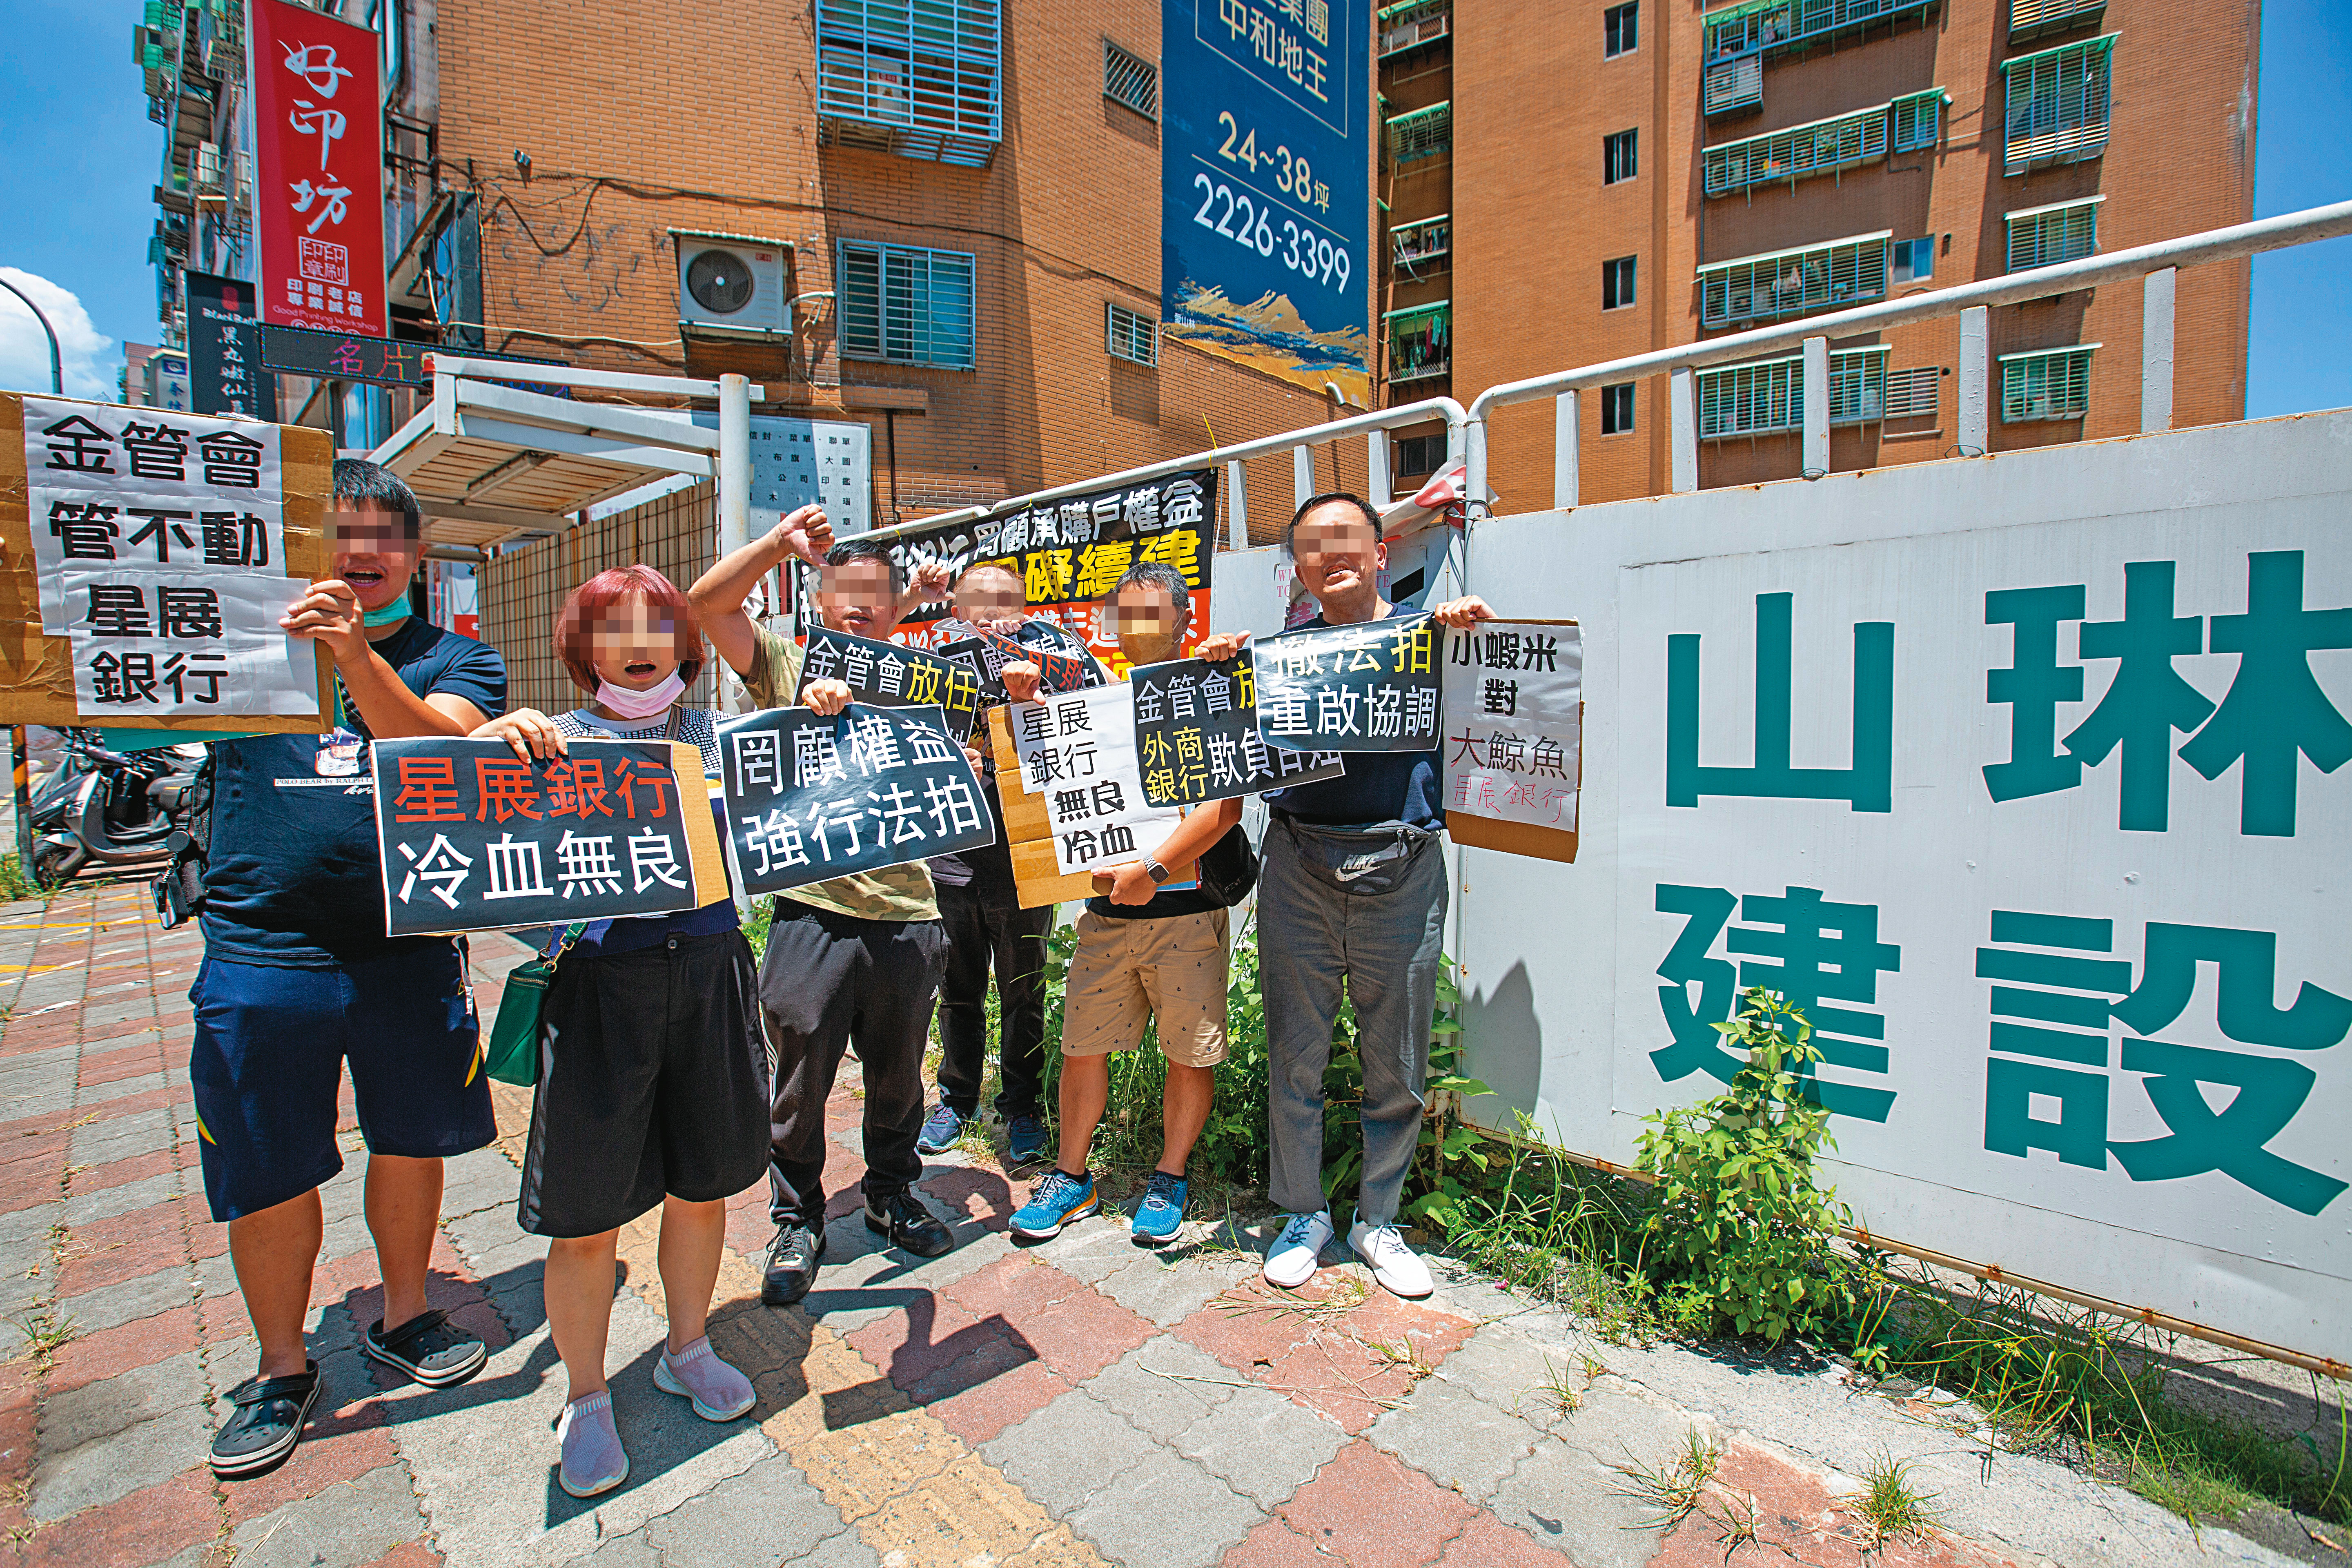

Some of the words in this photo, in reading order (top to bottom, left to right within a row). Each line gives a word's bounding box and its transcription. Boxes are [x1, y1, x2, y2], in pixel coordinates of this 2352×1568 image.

[1220, 0, 1328, 103] 中和地王
[277, 40, 353, 234] 好印坊
[1193, 173, 1350, 294] 2226-3399
[287, 278, 363, 305] 印刷老店
[287, 291, 363, 318] 專業誠信
[273, 305, 298, 316] Good
[299, 309, 334, 324] Printing
[334, 316, 378, 332] Workshop
[1174, 312, 1196, 330] 愛山林
[330, 339, 414, 380] 名片
[43, 415, 264, 489] 金管會
[48, 501, 270, 567] 管不動
[974, 479, 1203, 560] 罔顧承購戶權益
[975, 528, 1200, 602] 礙續建
[87, 584, 223, 639] 星展
[804, 636, 977, 713] 金管會放任
[1270, 621, 1432, 677] 撤法拍
[1451, 631, 1557, 673] 小蝦米
[89, 651, 228, 704] 銀行
[1484, 678, 1518, 716] 對
[1022, 699, 1092, 743] 星展
[1266, 684, 1437, 737] 重啟協調
[731, 714, 958, 797] 罔顧權益
[1028, 741, 1098, 785] 銀行
[1143, 726, 1203, 768] 外商
[1450, 728, 1567, 780] 大鯨魚
[394, 757, 672, 824] 星展銀行
[1054, 780, 1126, 824] 無良
[1145, 764, 1208, 804] 銀行
[1454, 774, 1570, 822] 星展銀行
[742, 775, 982, 877] 強行法拍
[1062, 823, 1136, 864] 冷血
[397, 826, 688, 910] 冷血無良
